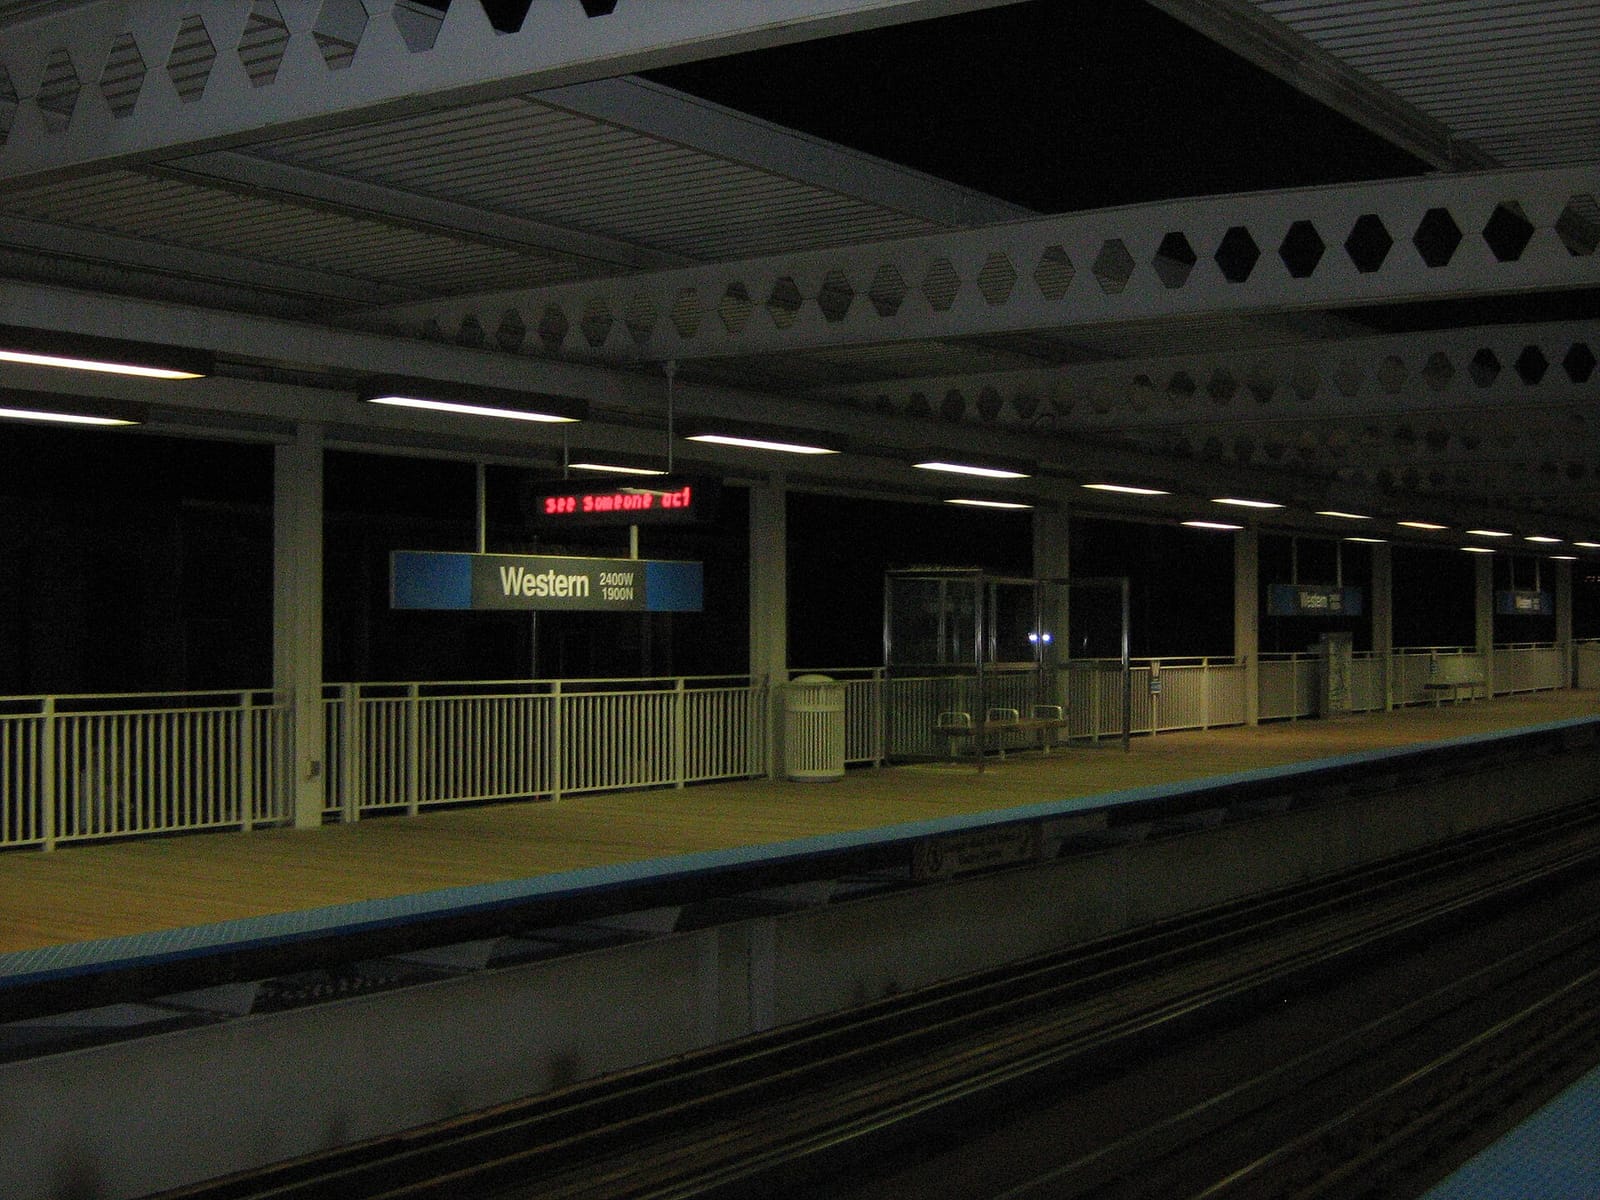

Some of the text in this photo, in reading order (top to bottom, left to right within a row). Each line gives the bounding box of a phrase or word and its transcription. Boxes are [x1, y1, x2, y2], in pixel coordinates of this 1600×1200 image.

[544, 496, 576, 514] see
[582, 493, 653, 512] someone
[500, 566, 589, 597] Western
[599, 572, 634, 586] 2400W
[601, 587, 634, 601] 1900N
